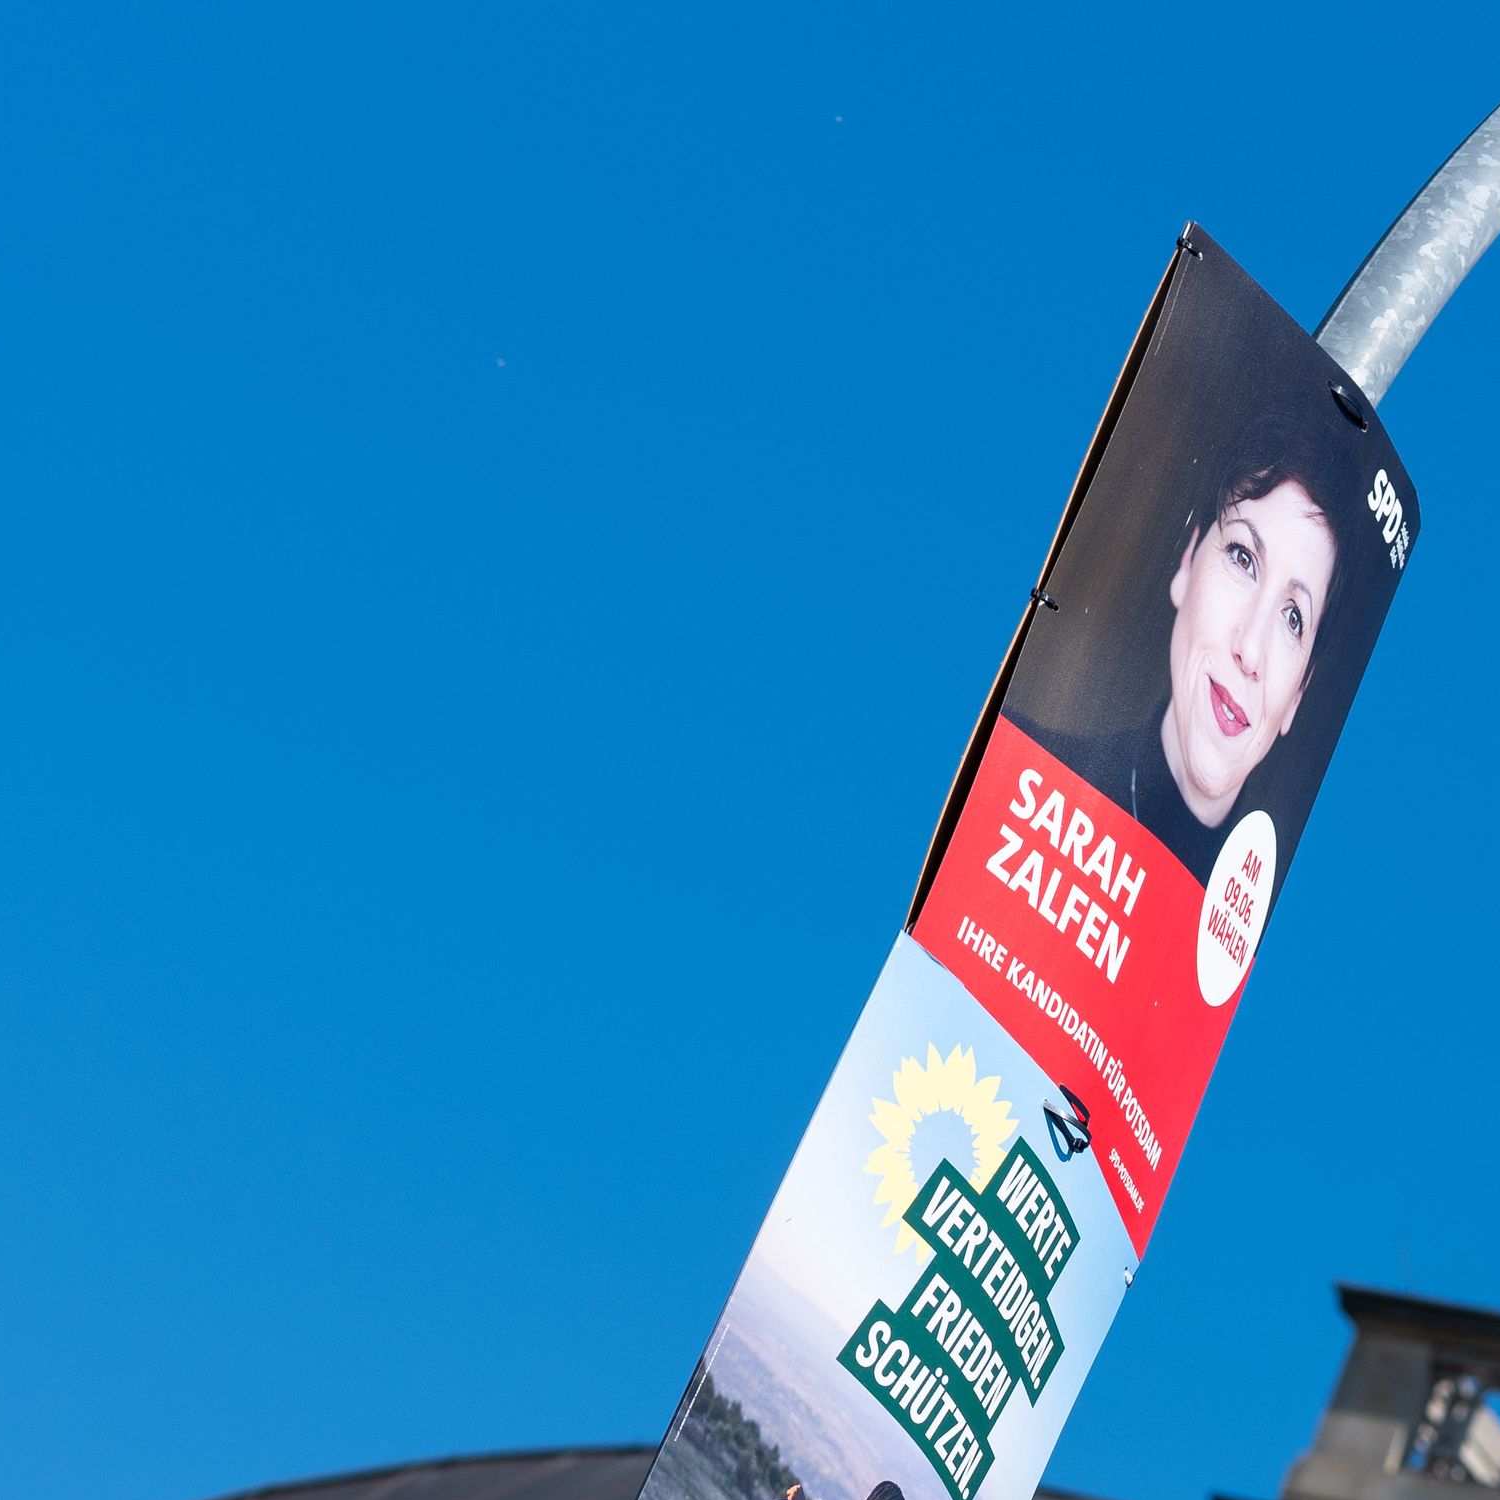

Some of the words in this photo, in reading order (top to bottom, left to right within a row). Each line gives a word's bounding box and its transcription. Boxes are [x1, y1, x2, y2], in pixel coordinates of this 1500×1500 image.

[1368, 469, 1403, 544] SPD
[985, 824, 1132, 985] ZALFEN
[1009, 768, 1147, 917] SARAH
[1224, 876, 1254, 929] 09.06.
[1241, 849, 1262, 887] AM
[1207, 904, 1249, 968] WÄHLEN
[957, 916, 1008, 973] IHRE
[1006, 957, 1108, 1072] KANDIDATIN
[1102, 1060, 1127, 1102] FÜR
[1120, 1086, 1163, 1172] POTSDAM
[997, 1153, 1072, 1280] WERTE
[1108, 1147, 1145, 1215] SPD-POTSDAM.DE
[911, 1272, 1013, 1420] FRIEDEN
[921, 1176, 1054, 1390] VERTEIDIGEN.
[855, 1320, 985, 1500] SCHÜTZEN.
